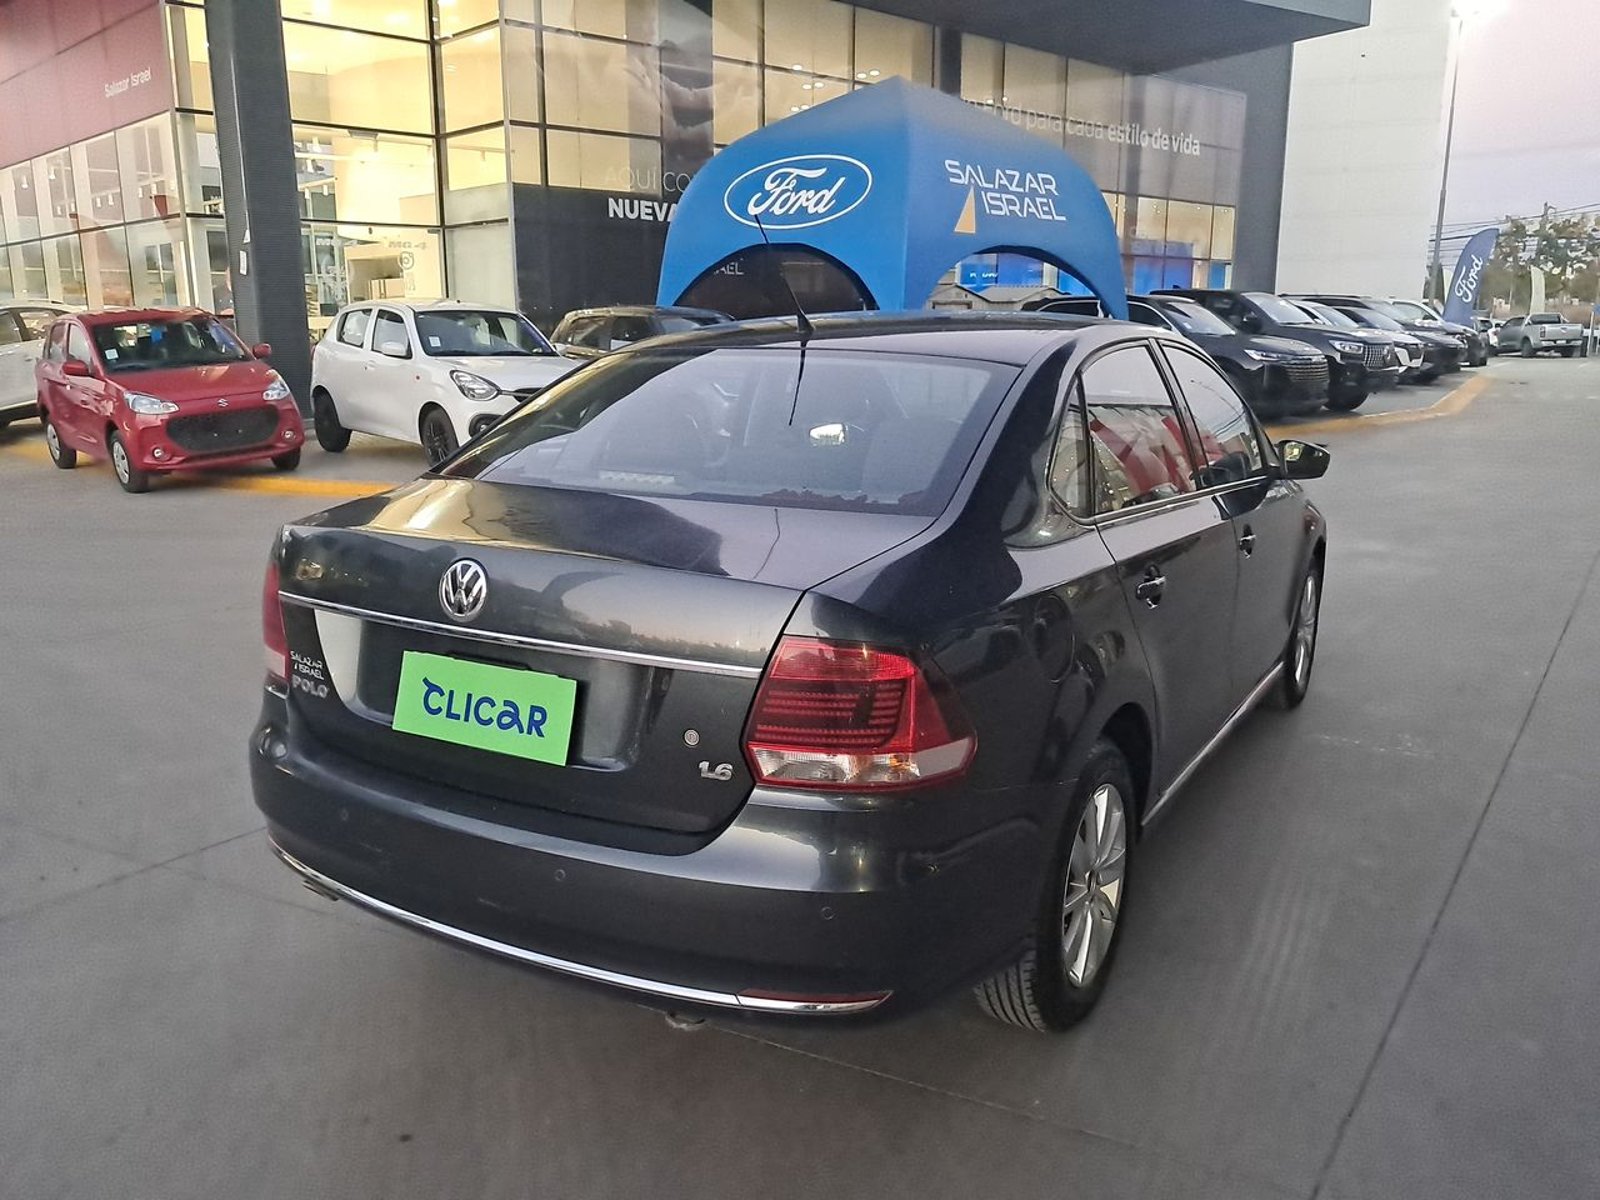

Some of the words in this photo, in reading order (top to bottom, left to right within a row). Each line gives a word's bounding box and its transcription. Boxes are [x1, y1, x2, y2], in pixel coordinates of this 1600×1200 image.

[1108, 123, 1149, 147] estilo
[1152, 127, 1170, 150] de
[1172, 132, 1200, 155] vida
[747, 167, 846, 215] Ford
[944, 159, 1059, 195] SALAZAR
[981, 190, 1067, 221] ISRAEL
[1454, 254, 1484, 303] Ford
[291, 674, 328, 699] POLO
